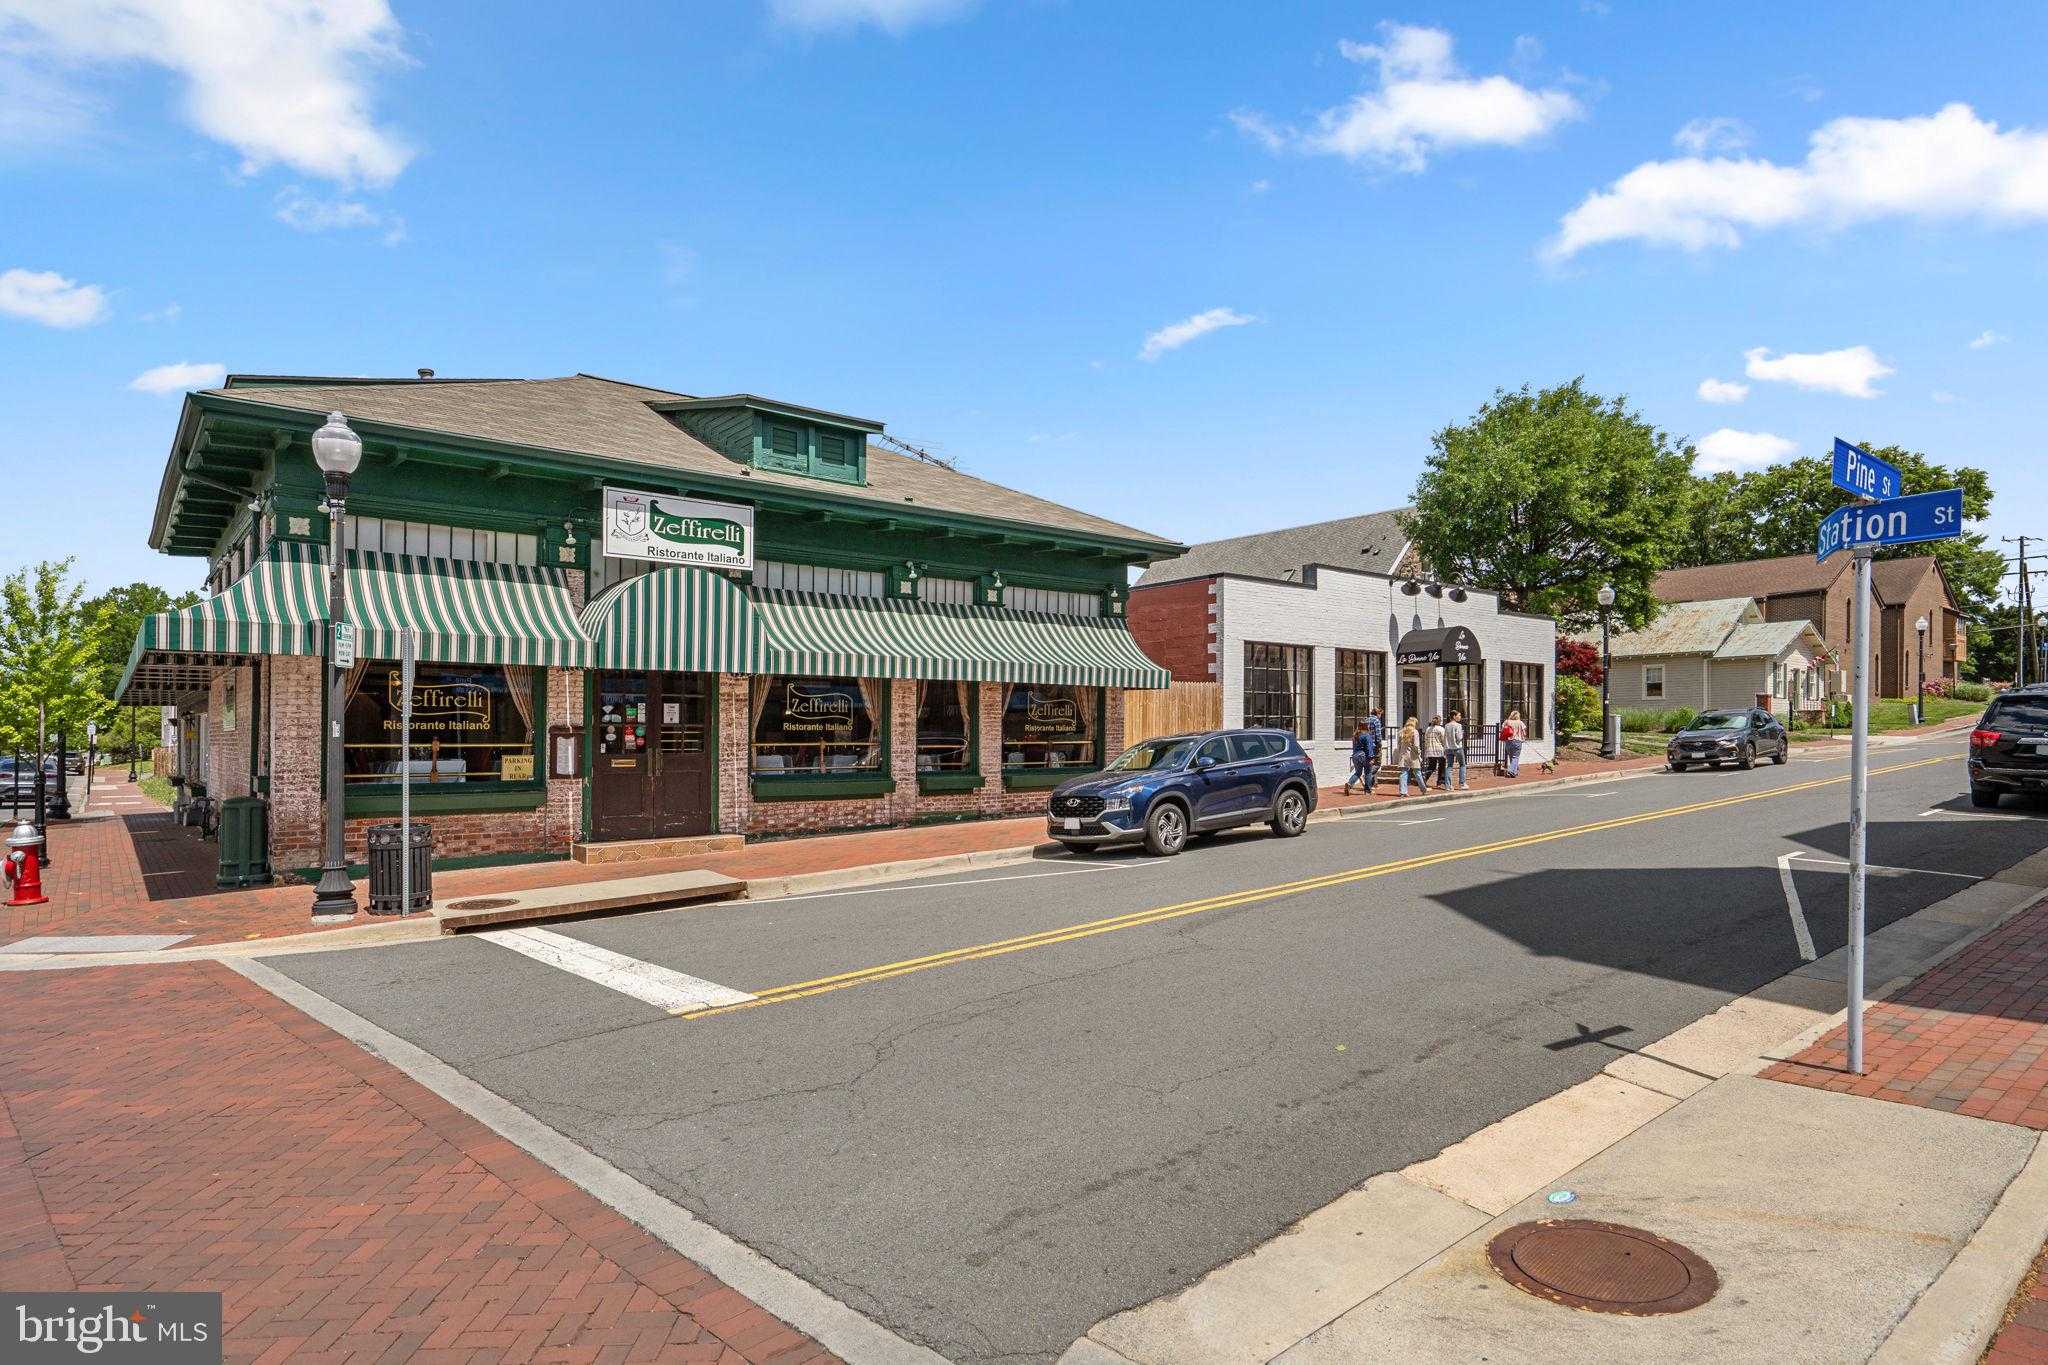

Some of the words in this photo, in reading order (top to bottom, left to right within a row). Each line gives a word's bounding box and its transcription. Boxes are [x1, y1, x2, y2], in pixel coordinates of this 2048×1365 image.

[1846, 449, 1876, 493] Pine
[1882, 475, 1891, 497] St
[654, 515, 741, 543] Zeffirelli
[1818, 509, 1907, 556] Station
[1934, 506, 1955, 525] St
[647, 545, 704, 562] Ristorante
[707, 551, 746, 565] Italiano
[791, 698, 849, 714] Zeffirelli
[383, 720, 446, 730] Risorante
[449, 720, 490, 730] Italiano
[783, 722, 823, 731] Ristorante
[826, 722, 853, 731] Italiano
